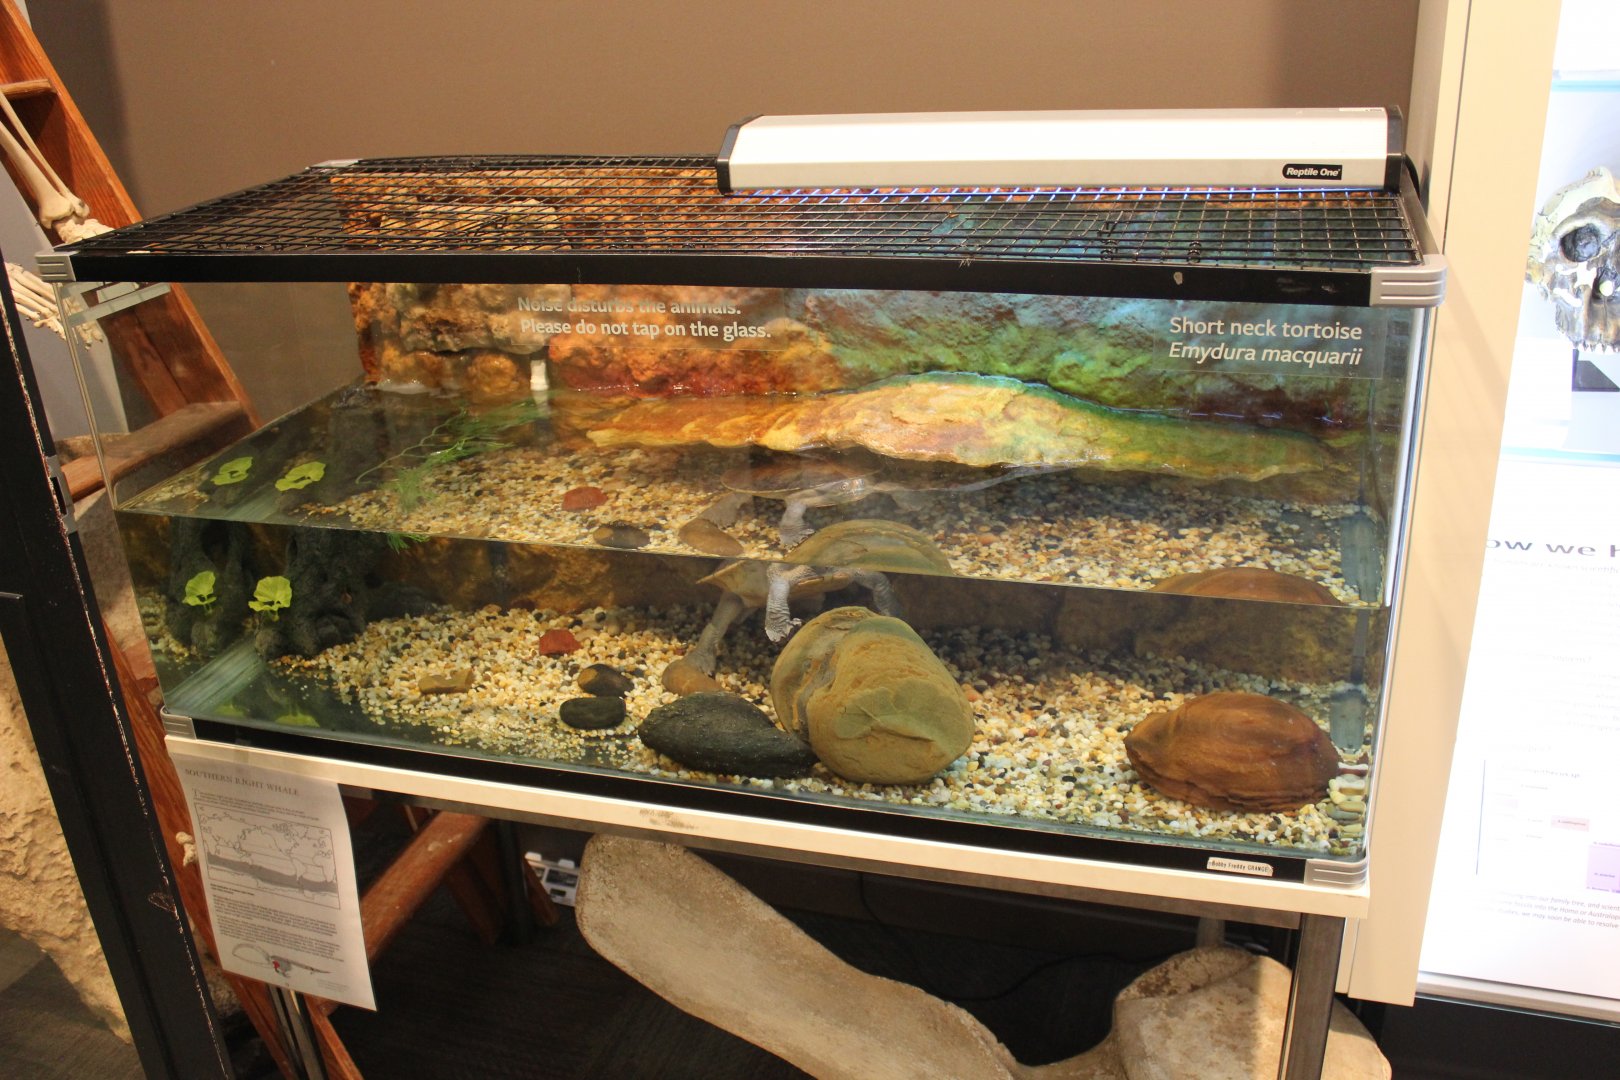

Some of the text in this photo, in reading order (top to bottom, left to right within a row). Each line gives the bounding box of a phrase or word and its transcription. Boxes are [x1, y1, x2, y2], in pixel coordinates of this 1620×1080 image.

[1286, 167, 1318, 177] Reptile
[518, 297, 741, 315] Noise disturbs the animals.
[521, 319, 771, 342] Please do not tap on the glass.
[1169, 317, 1362, 340] Short neck tortoise
[1169, 342, 1363, 368] Emydura macquarii
[1546, 543, 1596, 557] we
[185, 768, 298, 796] SOUTHERN RIGHT WHALE
